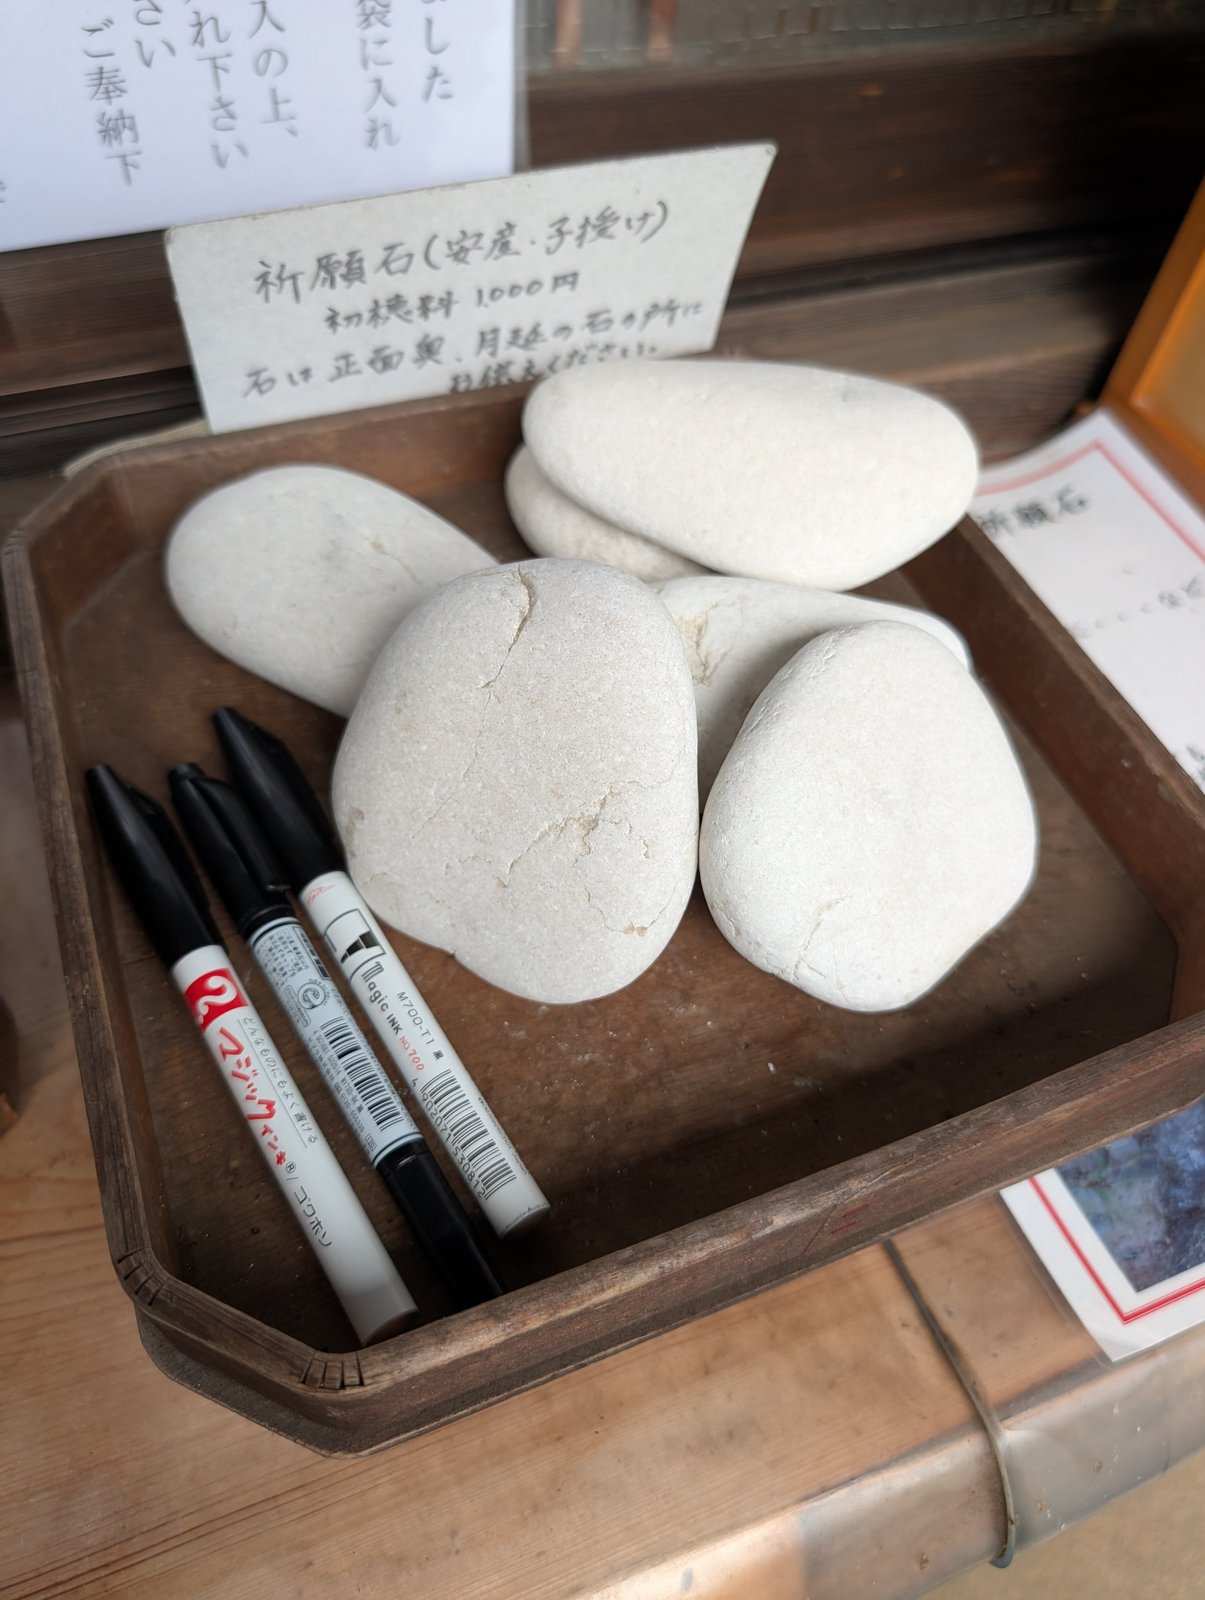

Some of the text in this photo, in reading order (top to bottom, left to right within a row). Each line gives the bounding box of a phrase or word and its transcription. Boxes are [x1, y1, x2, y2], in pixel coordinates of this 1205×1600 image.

[80, 19, 143, 186] ご奉納下
[188, 0, 249, 169] れ下さい
[356, 0, 400, 151] 袋に入れ
[420, 0, 455, 103] した
[361, 960, 390, 1013] Magic
[386, 1012, 403, 1036] INK
[396, 990, 436, 1046] M700-T1
[421, 1092, 452, 1142] 902071
[452, 1146, 486, 1199] 530812
